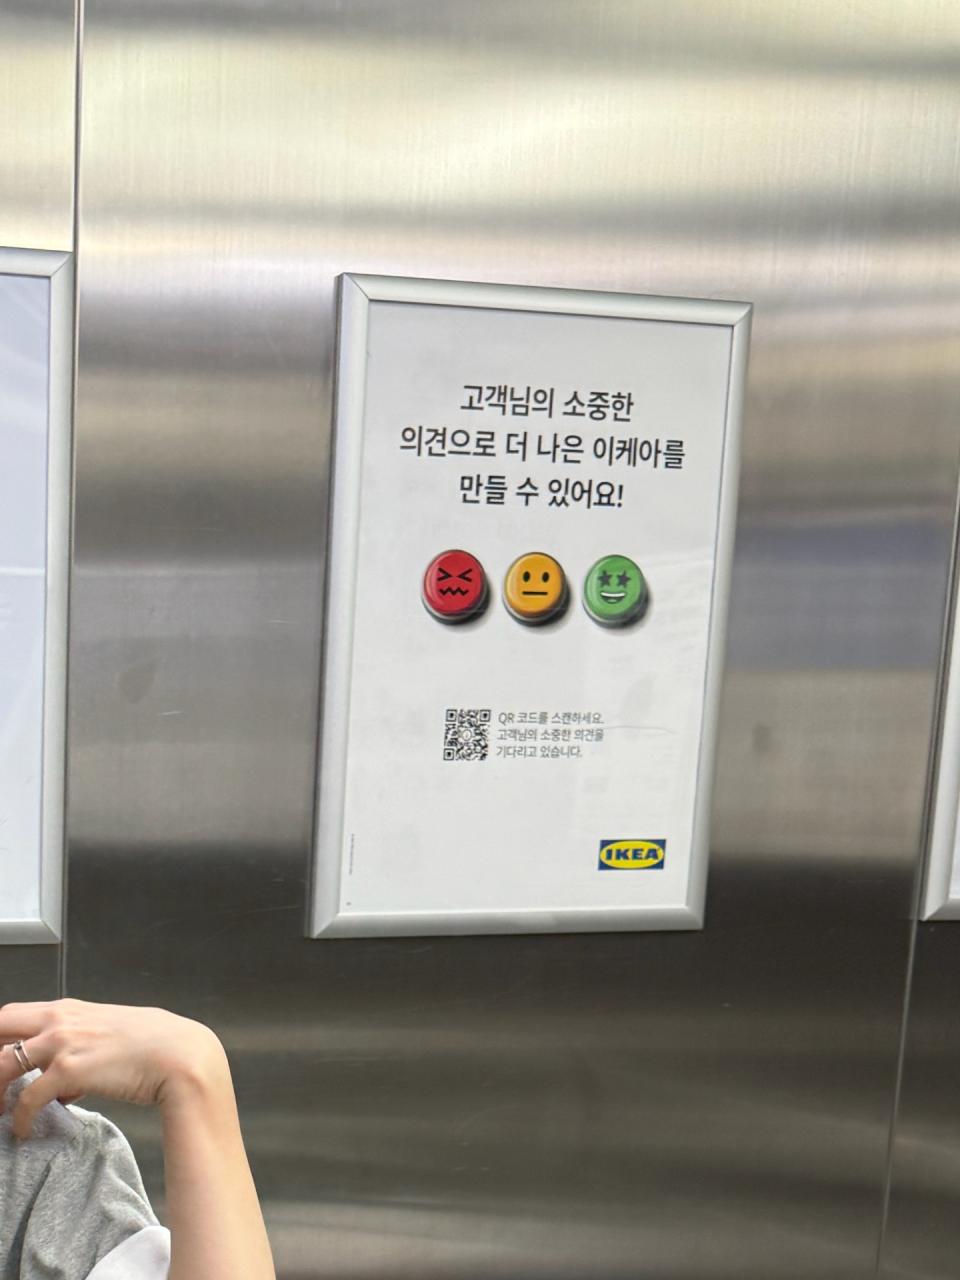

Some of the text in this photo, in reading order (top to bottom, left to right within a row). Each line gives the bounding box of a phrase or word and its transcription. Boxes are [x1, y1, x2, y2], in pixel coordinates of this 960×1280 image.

[460, 385, 635, 422] 고객님의 소중한
[400, 425, 686, 469] 의견으로 더 나은 이케아를
[460, 474, 624, 509] 만들 수 있어요!
[498, 712, 514, 726] QR
[517, 712, 548, 725] 코드를
[496, 728, 604, 742] 고객님의 소중한 의견을
[496, 745, 583, 759] 기다리고 있습니다.
[605, 847, 660, 861] IKEA
